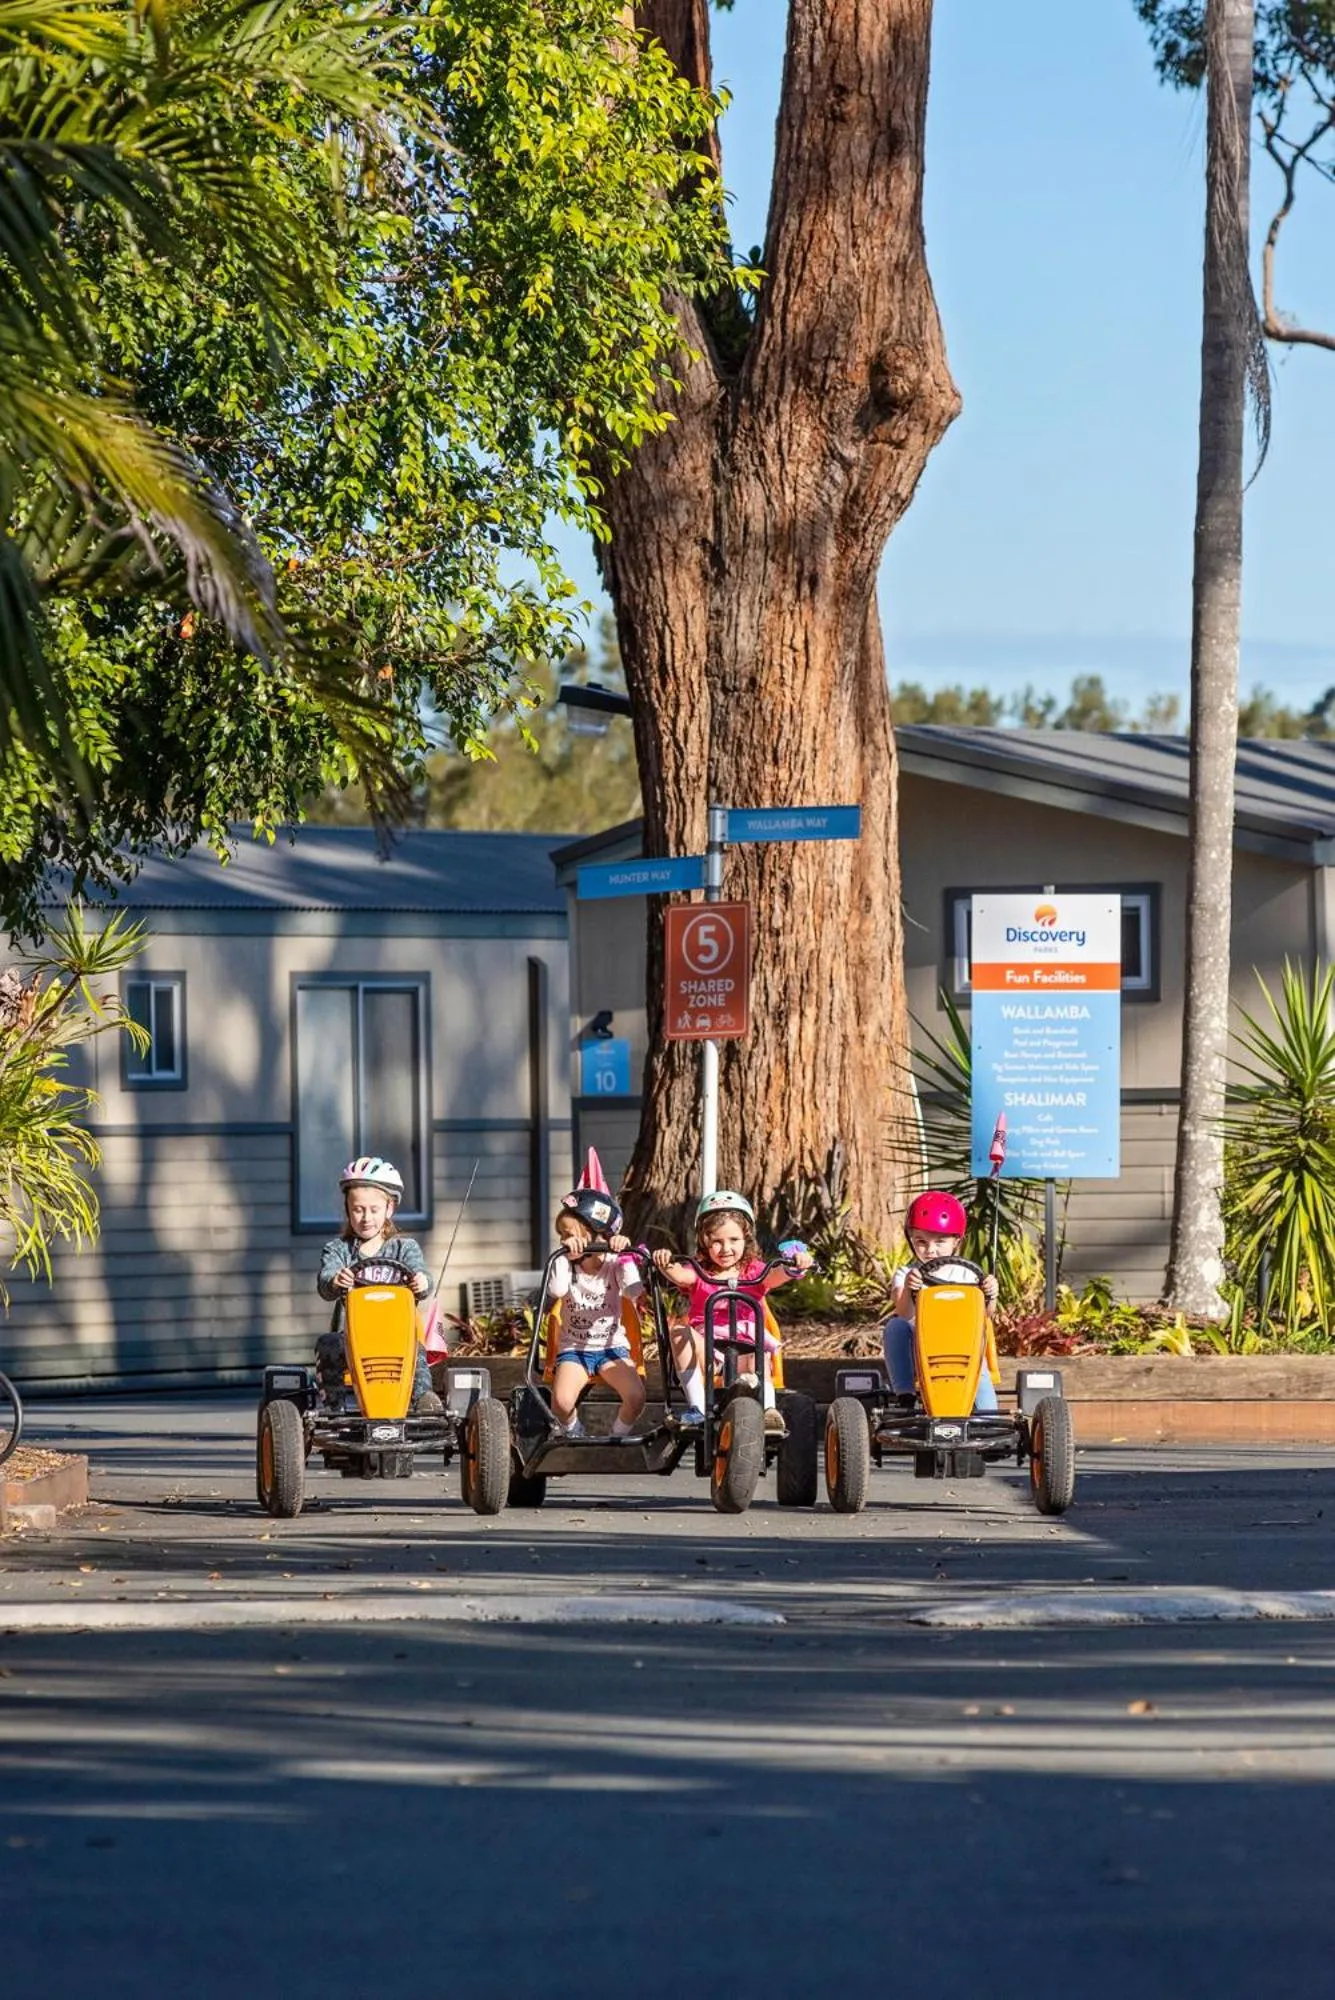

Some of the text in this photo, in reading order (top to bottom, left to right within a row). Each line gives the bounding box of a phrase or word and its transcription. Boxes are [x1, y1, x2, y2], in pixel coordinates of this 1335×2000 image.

[747, 817, 828, 830] WALLAMBA WAY
[609, 870, 672, 885] HUNTER WAY
[697, 924, 719, 964] 5
[1006, 927, 1086, 946] Discovery
[1005, 969, 1087, 984] Fun Facilities
[680, 979, 735, 993] SHARED
[688, 994, 726, 1008] ZONE
[1001, 1005, 1091, 1019] WALLAMBA
[594, 1070, 617, 1092] 10
[1004, 1092, 1087, 1107] SHALIMAR
